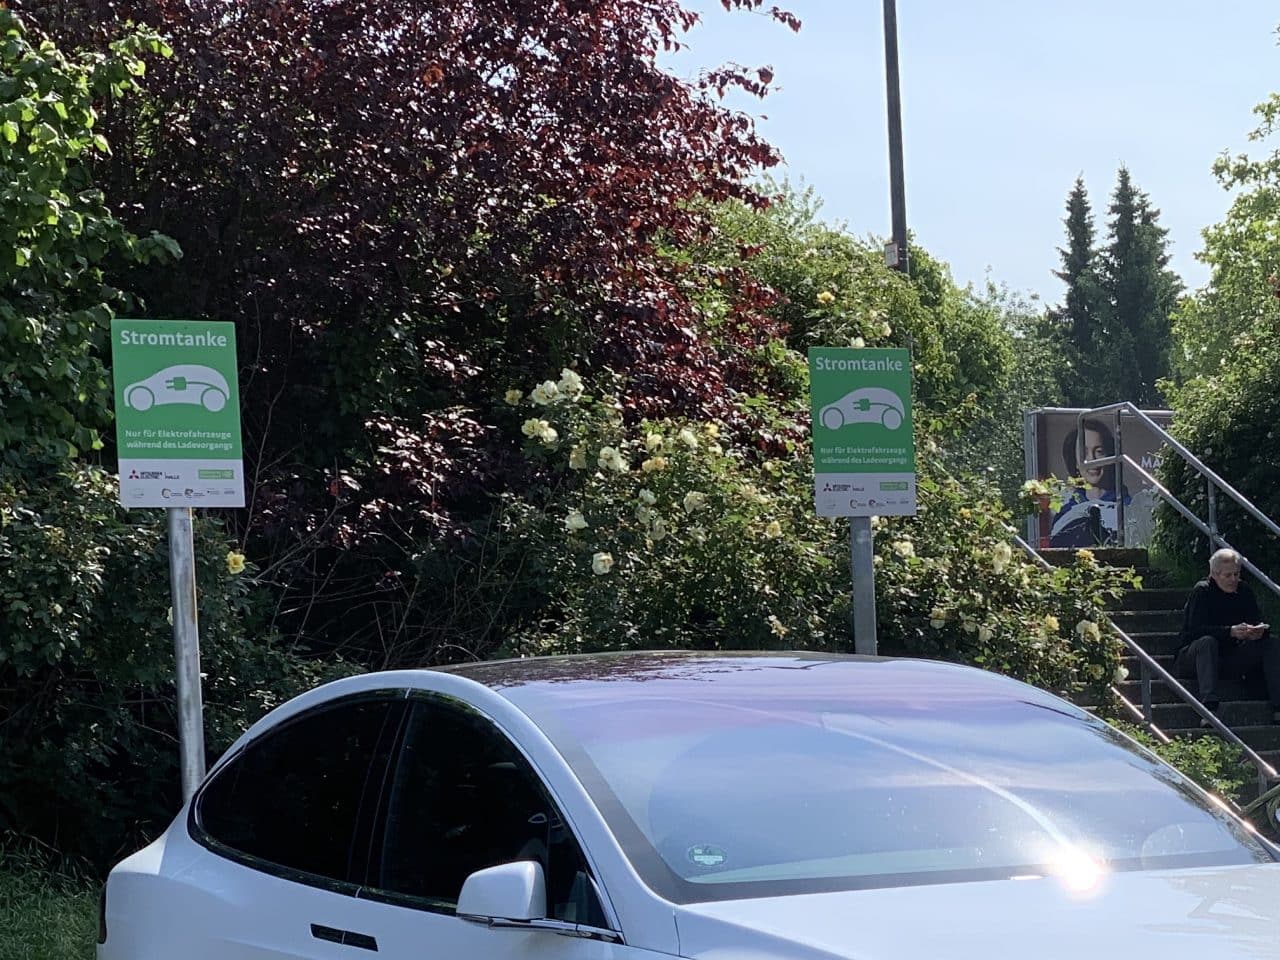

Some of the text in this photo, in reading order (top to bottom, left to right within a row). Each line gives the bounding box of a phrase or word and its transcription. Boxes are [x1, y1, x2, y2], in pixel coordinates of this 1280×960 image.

[120, 330, 227, 347] Stromtanke
[816, 357, 903, 371] Stromtanke
[125, 429, 232, 440] Nur für Elektrofahrzeuge
[126, 441, 233, 450] während des Ladevorgangs
